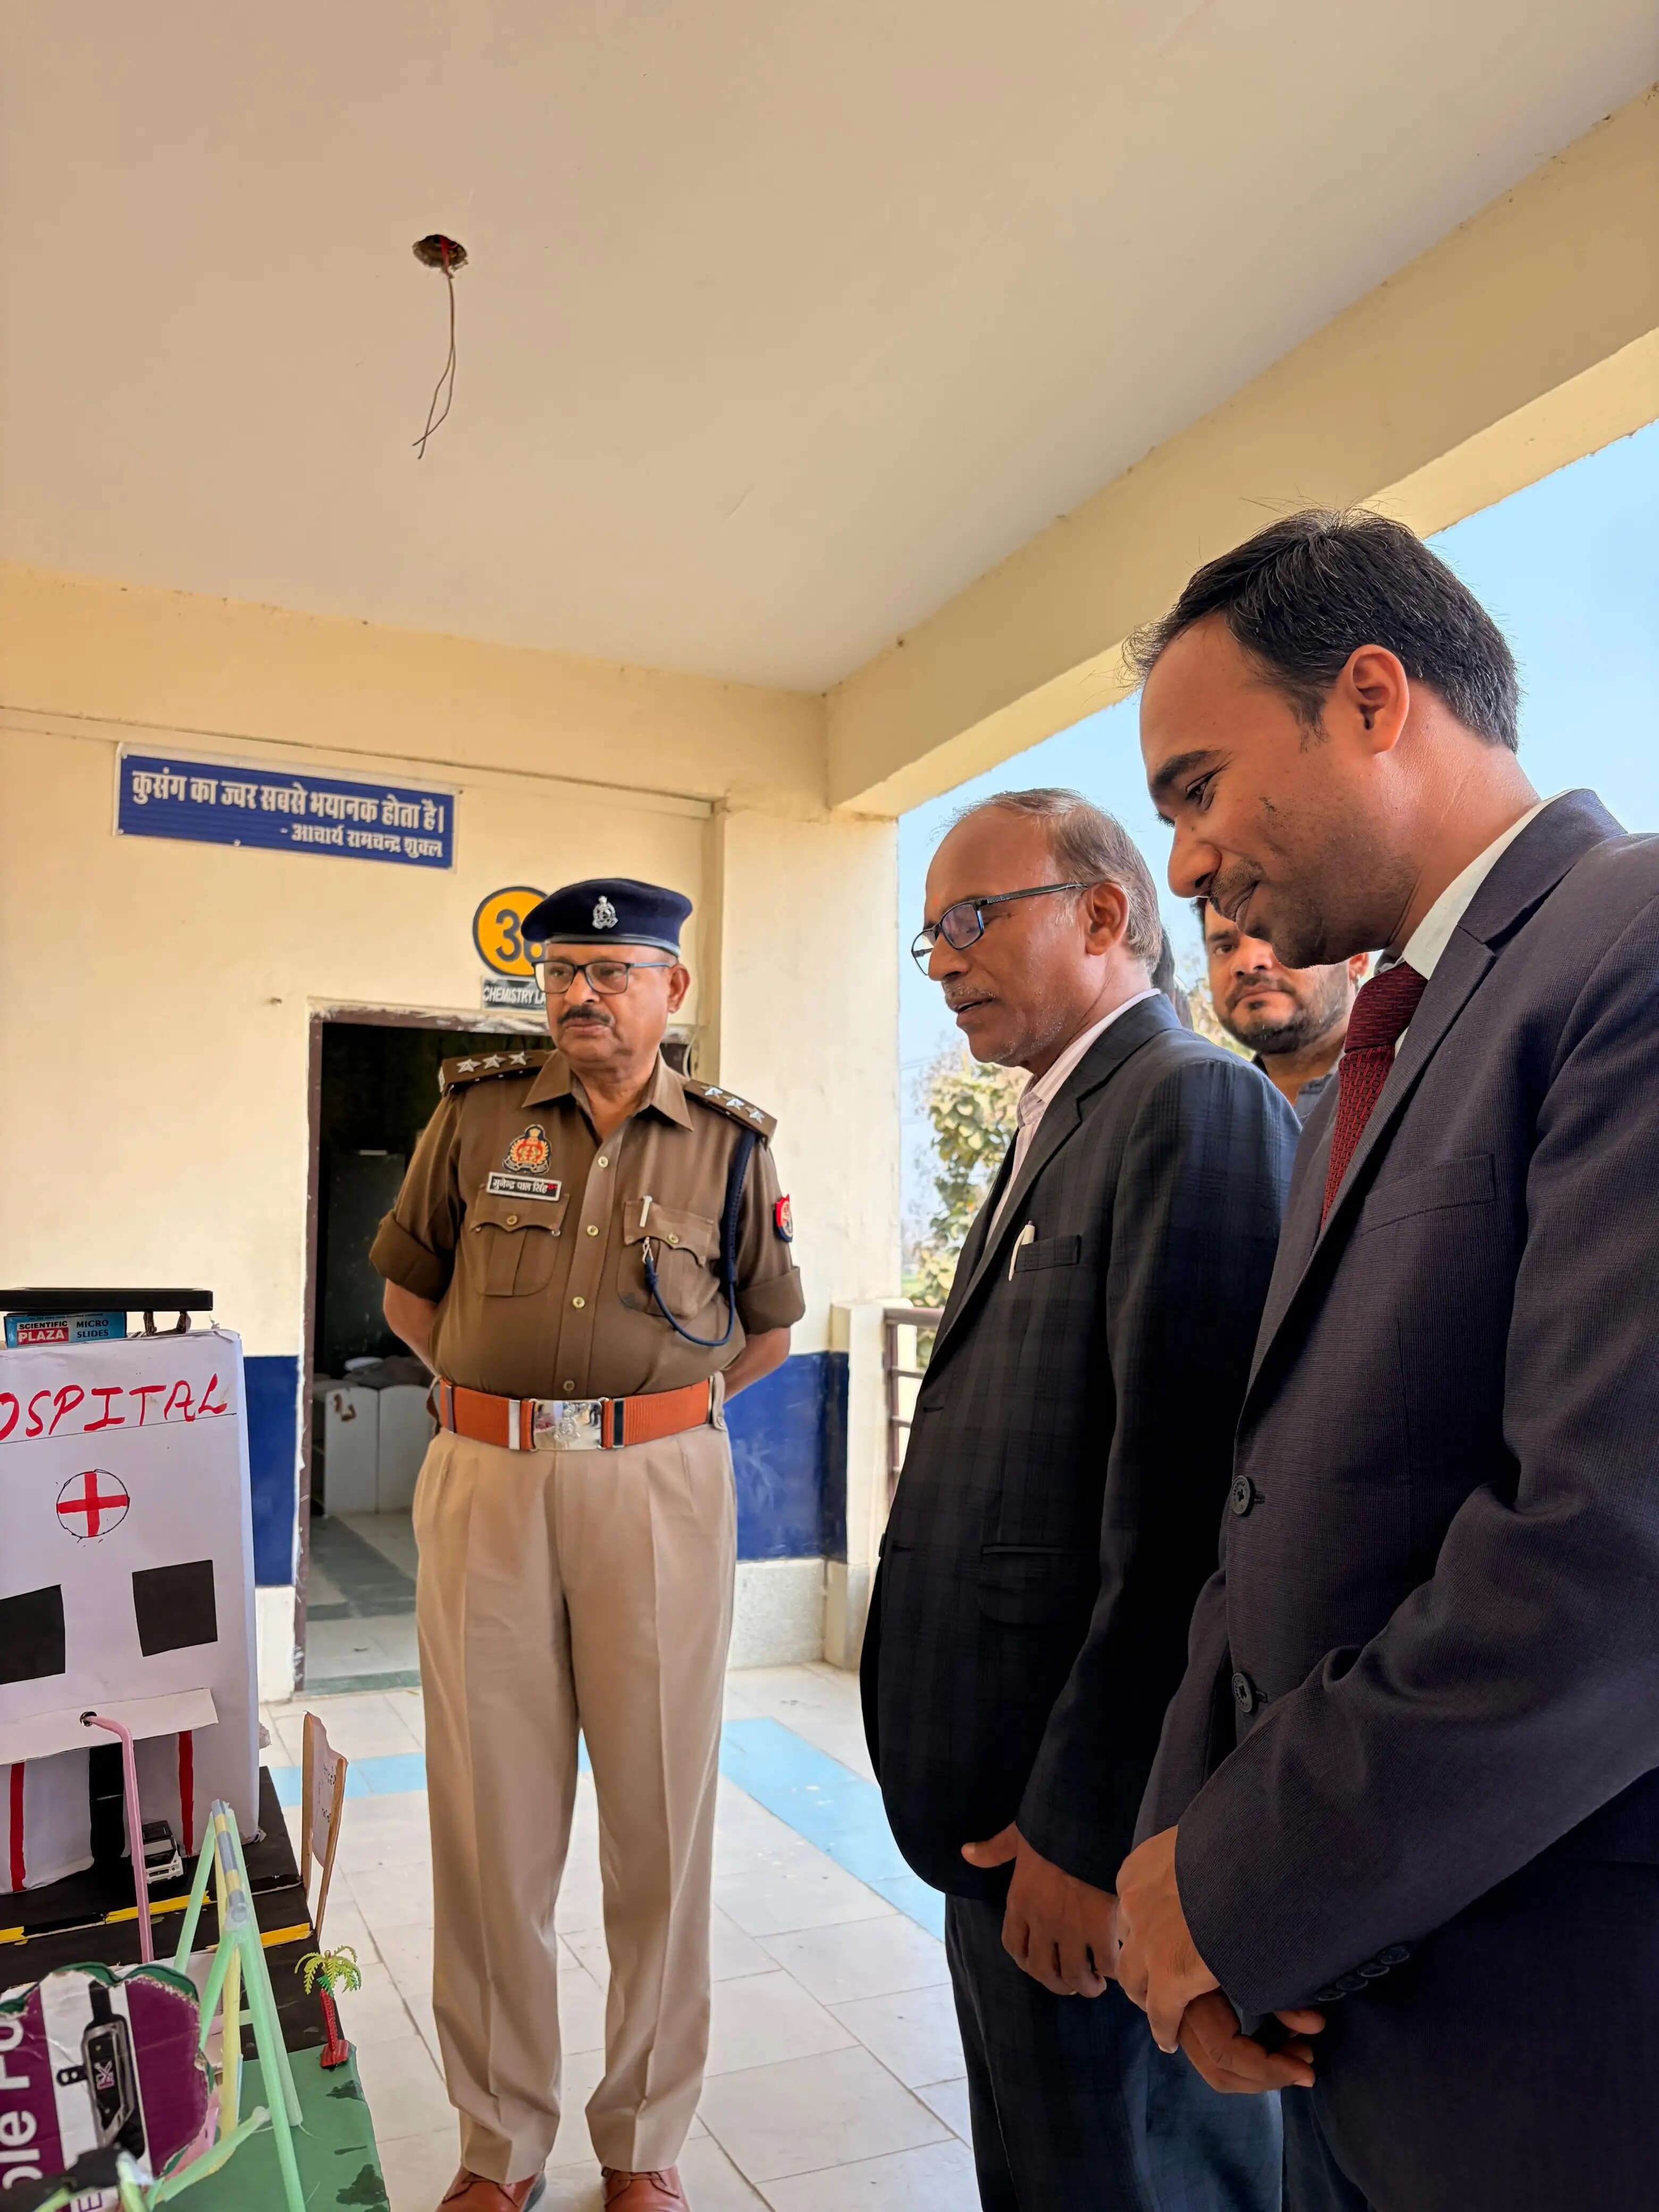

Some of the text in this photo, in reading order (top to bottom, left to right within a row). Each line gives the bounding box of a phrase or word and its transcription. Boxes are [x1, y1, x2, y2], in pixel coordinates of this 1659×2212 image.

[132, 766, 188, 805] कुसंग
[190, 777, 218, 805] का
[221, 781, 258, 809] ज्वर
[261, 782, 308, 815] सबसे
[310, 791, 379, 823] भयानक
[381, 793, 421, 828] होता
[291, 824, 345, 846] आचार्य
[347, 830, 401, 852] रामचन्द्र
[404, 836, 443, 858] शुक्ल
[484, 985, 534, 1004] CHEMISTRY
[19, 1321, 68, 1329] SCIENTIFIC
[77, 1319, 109, 1328] MICRO
[18, 1330, 65, 1342] PLAZA
[77, 1329, 109, 1338] SLIDES
